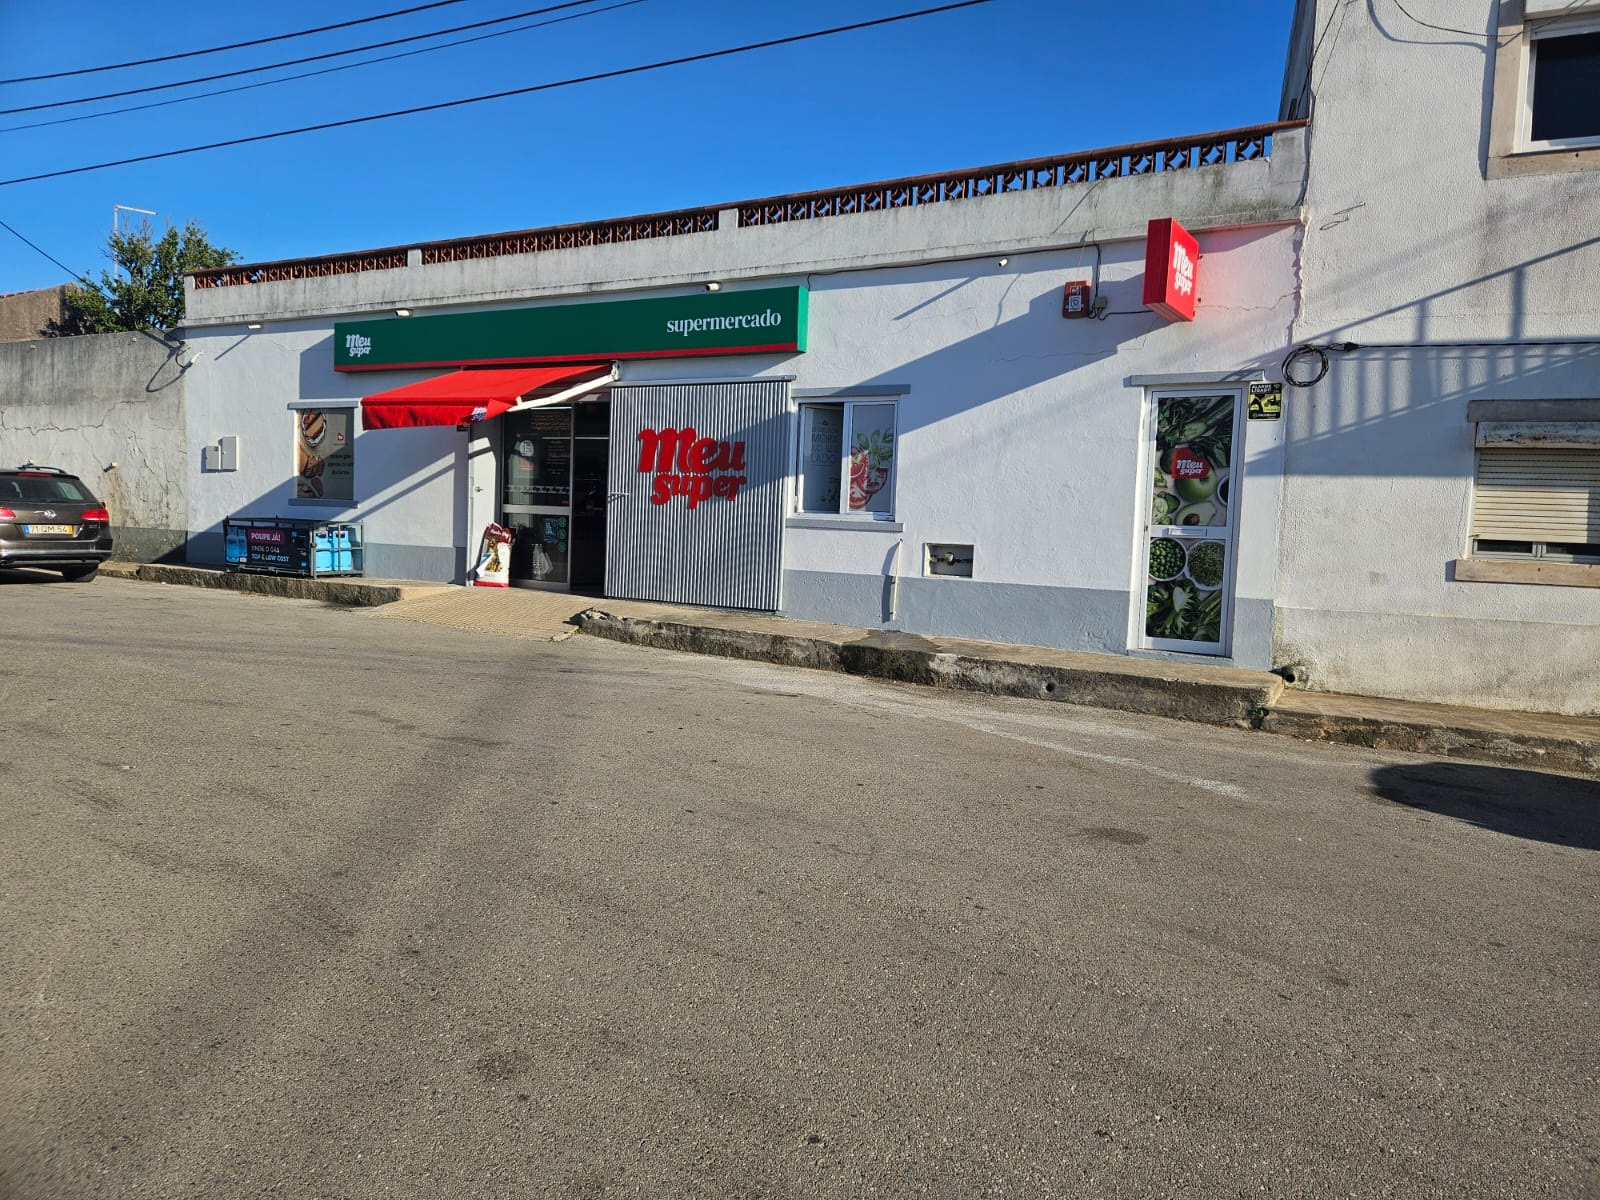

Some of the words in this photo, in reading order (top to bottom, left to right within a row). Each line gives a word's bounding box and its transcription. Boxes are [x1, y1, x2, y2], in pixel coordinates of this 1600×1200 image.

[1173, 241, 1193, 279] Meu
[1174, 271, 1193, 296] super
[666, 308, 782, 337] supermercado
[345, 333, 371, 348] Meu
[349, 347, 371, 358] super
[637, 426, 746, 473] Meu
[1176, 459, 1203, 469] Meu
[1179, 468, 1204, 476] super
[651, 473, 747, 510] super
[251, 532, 271, 541] POUPE
